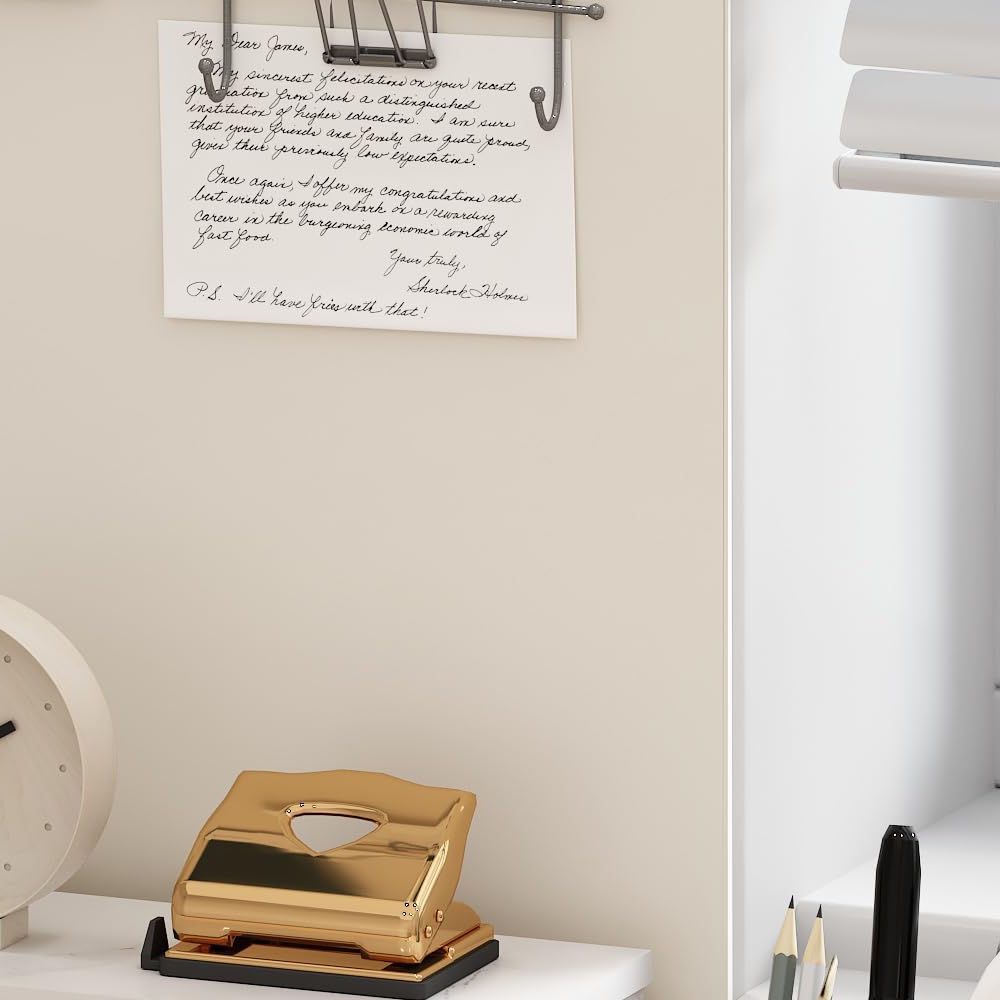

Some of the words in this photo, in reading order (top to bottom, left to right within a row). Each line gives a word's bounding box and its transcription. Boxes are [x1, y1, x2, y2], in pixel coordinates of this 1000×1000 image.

[183, 31, 213, 56] My
[266, 35, 308, 61] James,
[246, 69, 314, 83] sincerest
[315, 69, 407, 91] felicitations
[409, 78, 432, 88] on
[429, 78, 470, 98] your
[472, 81, 517, 92] recent
[187, 103, 271, 116] institution
[270, 106, 292, 130] of
[294, 103, 341, 125] higher
[345, 112, 419, 125] education.
[431, 112, 447, 124] I
[449, 116, 475, 127] am
[477, 119, 516, 128] sure
[269, 88, 314, 109] from
[315, 90, 354, 104] such
[360, 95, 374, 103] a
[377, 94, 481, 115] distinguished
[188, 115, 223, 131] that
[225, 124, 264, 142] your
[264, 121, 322, 143] friends
[326, 128, 357, 139] and
[350, 126, 403, 149] family
[410, 133, 438, 142] are
[437, 133, 481, 151] quite
[477, 133, 531, 153] proud,
[189, 138, 229, 159] given
[232, 138, 268, 151] their
[271, 145, 350, 169] previously
[358, 144, 389, 159] low
[390, 151, 476, 168] expectations.
[207, 165, 246, 185] Once
[249, 177, 294, 197] again,
[298, 174, 314, 187] I
[313, 177, 349, 198] offer
[350, 186, 374, 204] my
[379, 186, 485, 206] congratulations
[487, 193, 522, 203] and
[191, 185, 227, 202] best
[226, 193, 274, 206] wishes
[278, 199, 295, 207] as
[299, 201, 328, 217] you
[332, 200, 387, 213] embark
[391, 205, 413, 214] on
[413, 207, 428, 216] a
[426, 208, 495, 232] rewarding
[192, 224, 234, 250] fast
[194, 210, 239, 223] career
[244, 213, 265, 224] in
[266, 211, 293, 225] the
[299, 213, 371, 240] burgeoning
[377, 221, 440, 237] economic
[443, 225, 490, 238] world
[491, 229, 508, 247] of
[423, 251, 466, 278] truly,
[233, 287, 267, 303] I'll
[271, 287, 306, 309] have
[301, 294, 346, 318] fries
[343, 300, 383, 313] with
[407, 276, 471, 299] Sherlock
[469, 283, 529, 301] Holmes
